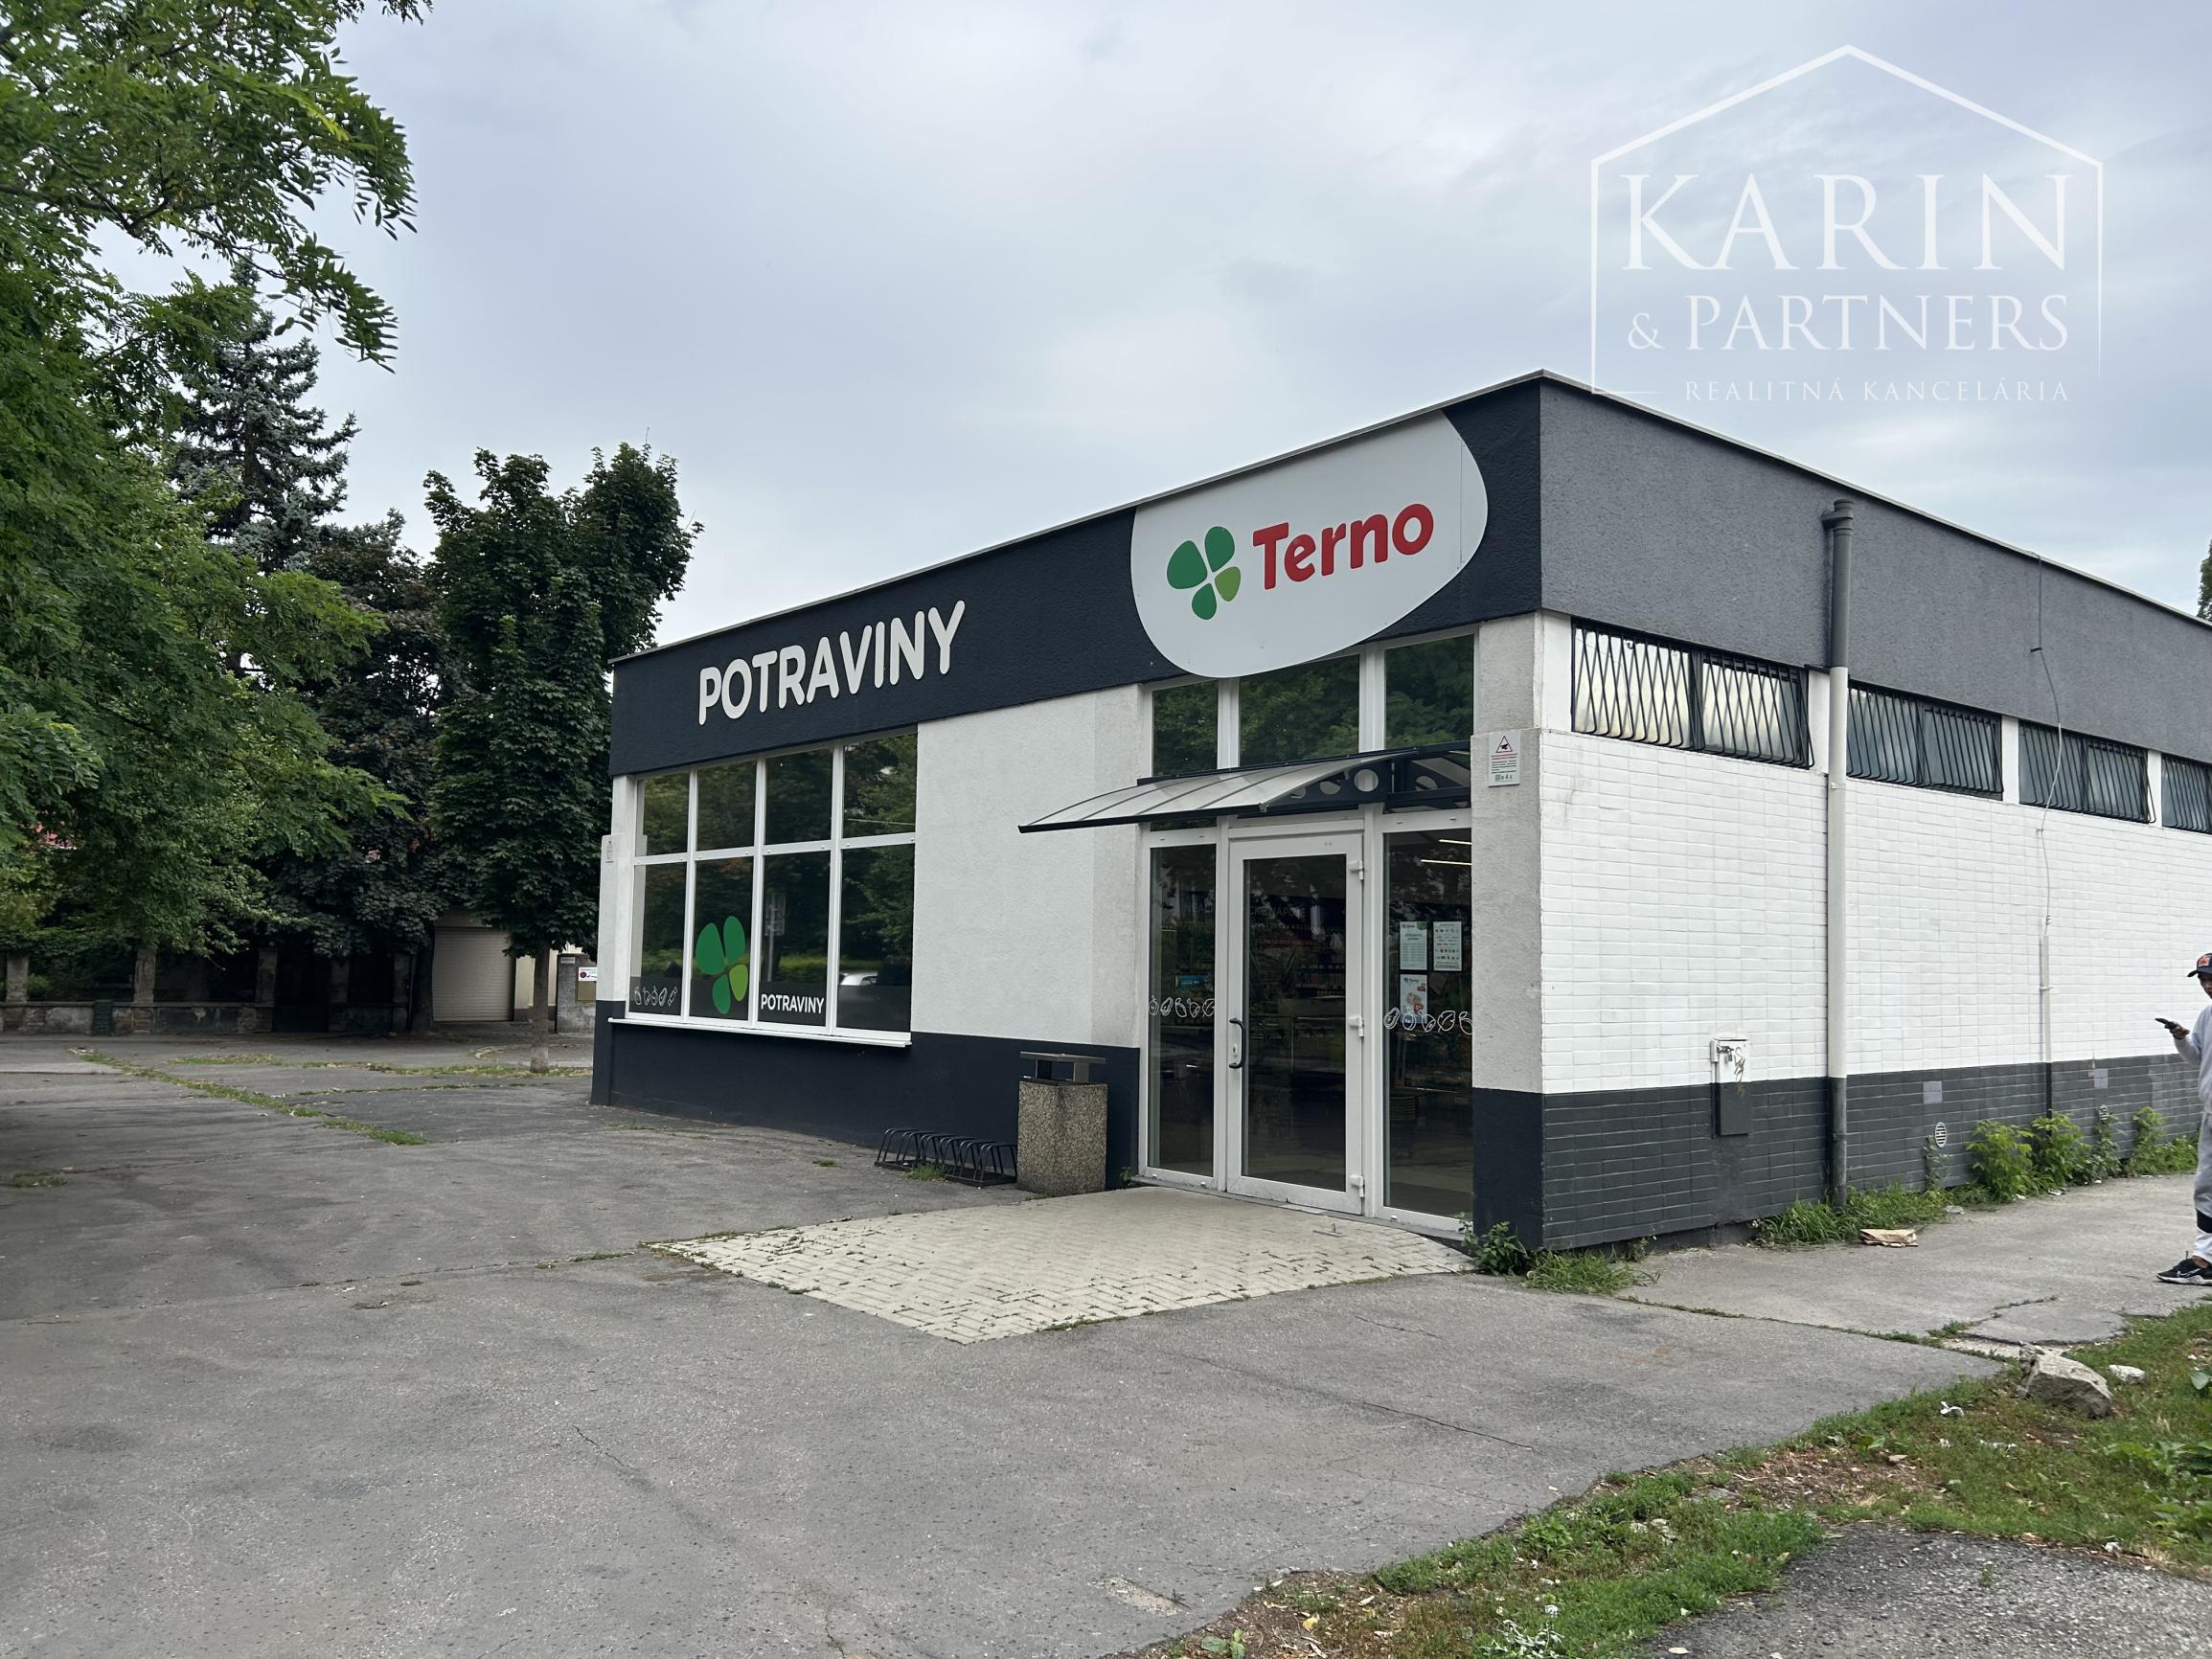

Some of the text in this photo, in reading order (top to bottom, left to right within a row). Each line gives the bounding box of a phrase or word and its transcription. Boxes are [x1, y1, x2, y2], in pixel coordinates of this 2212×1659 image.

[1253, 503, 1433, 590] Terno
[698, 600, 966, 726] POTRAVINY
[761, 993, 825, 1014] POTRAVINY
